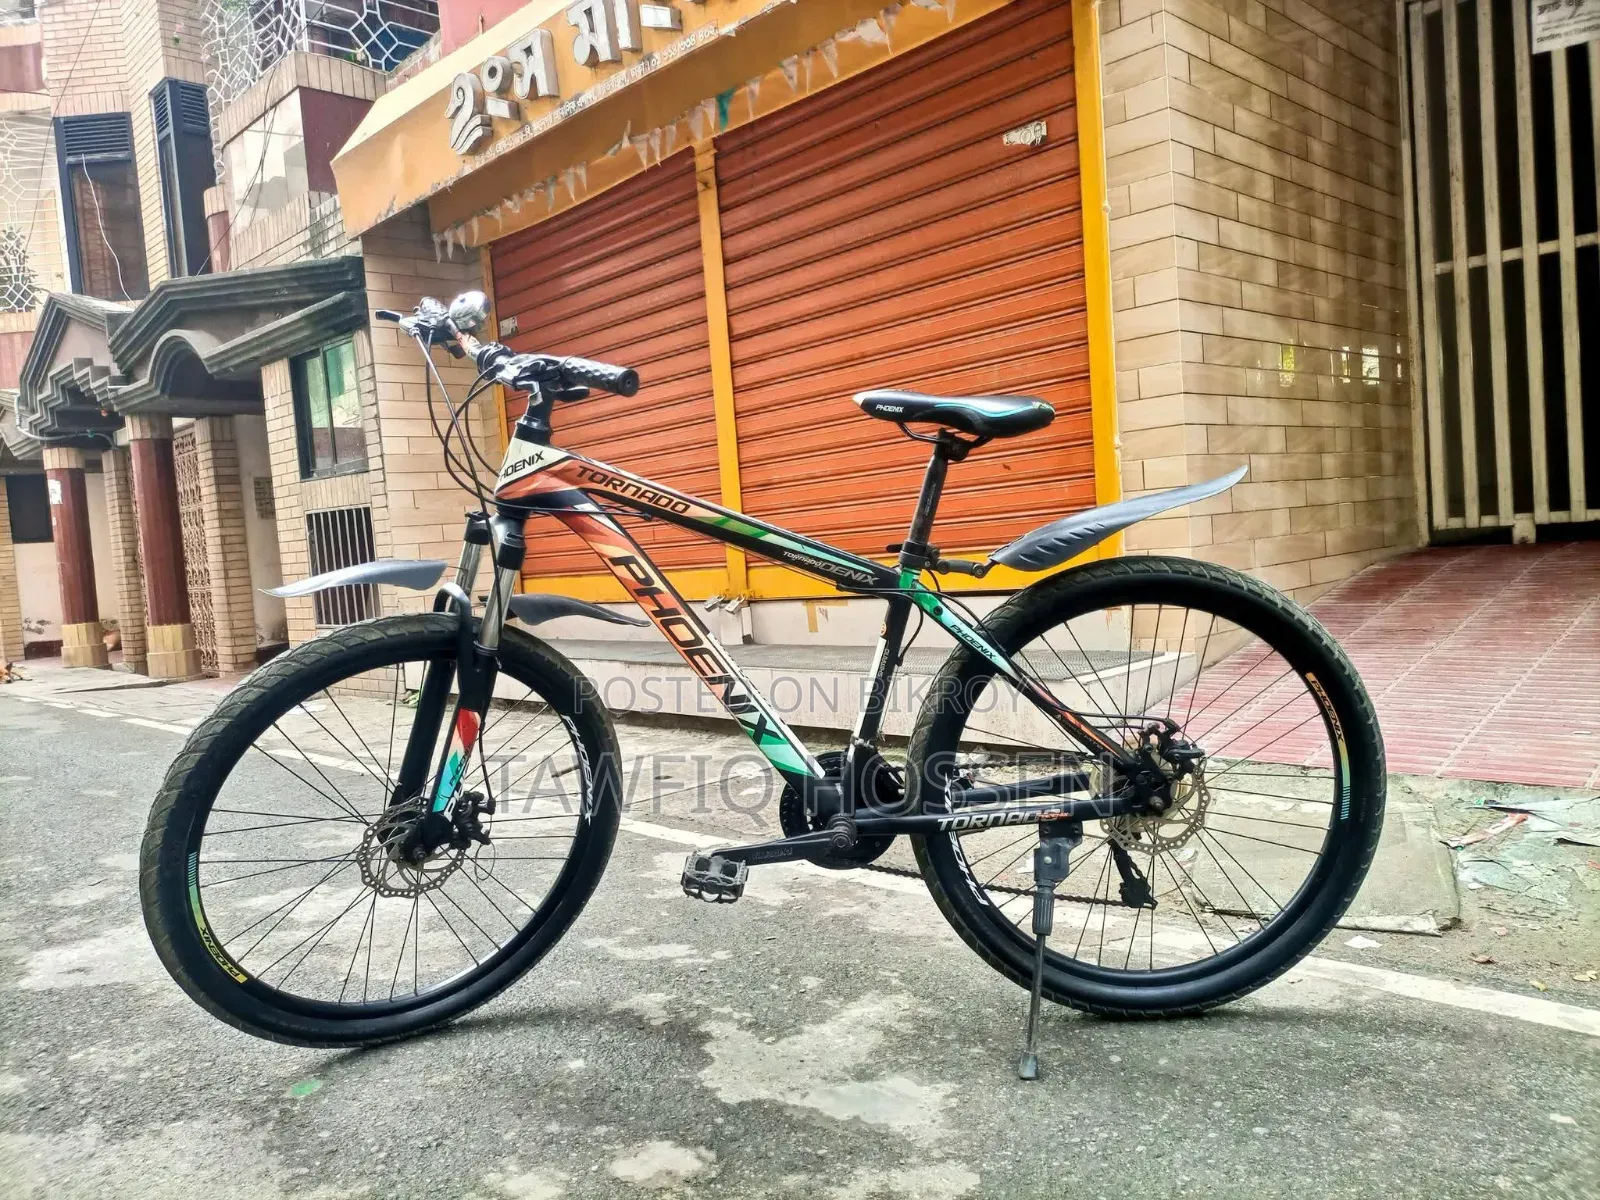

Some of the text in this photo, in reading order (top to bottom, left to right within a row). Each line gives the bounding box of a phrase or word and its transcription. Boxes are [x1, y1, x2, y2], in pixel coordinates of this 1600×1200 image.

[876, 404, 905, 413] PHOENIX
[501, 451, 545, 479] HOENIX
[576, 460, 691, 514] TORNADO
[819, 563, 880, 585] OENIX
[609, 555, 784, 745] PHOENIX
[950, 624, 997, 660] PHOENIX
[1311, 680, 1344, 742] PHOENIX
[561, 714, 593, 826] PHOENIX
[200, 926, 240, 978] PHOENIX
